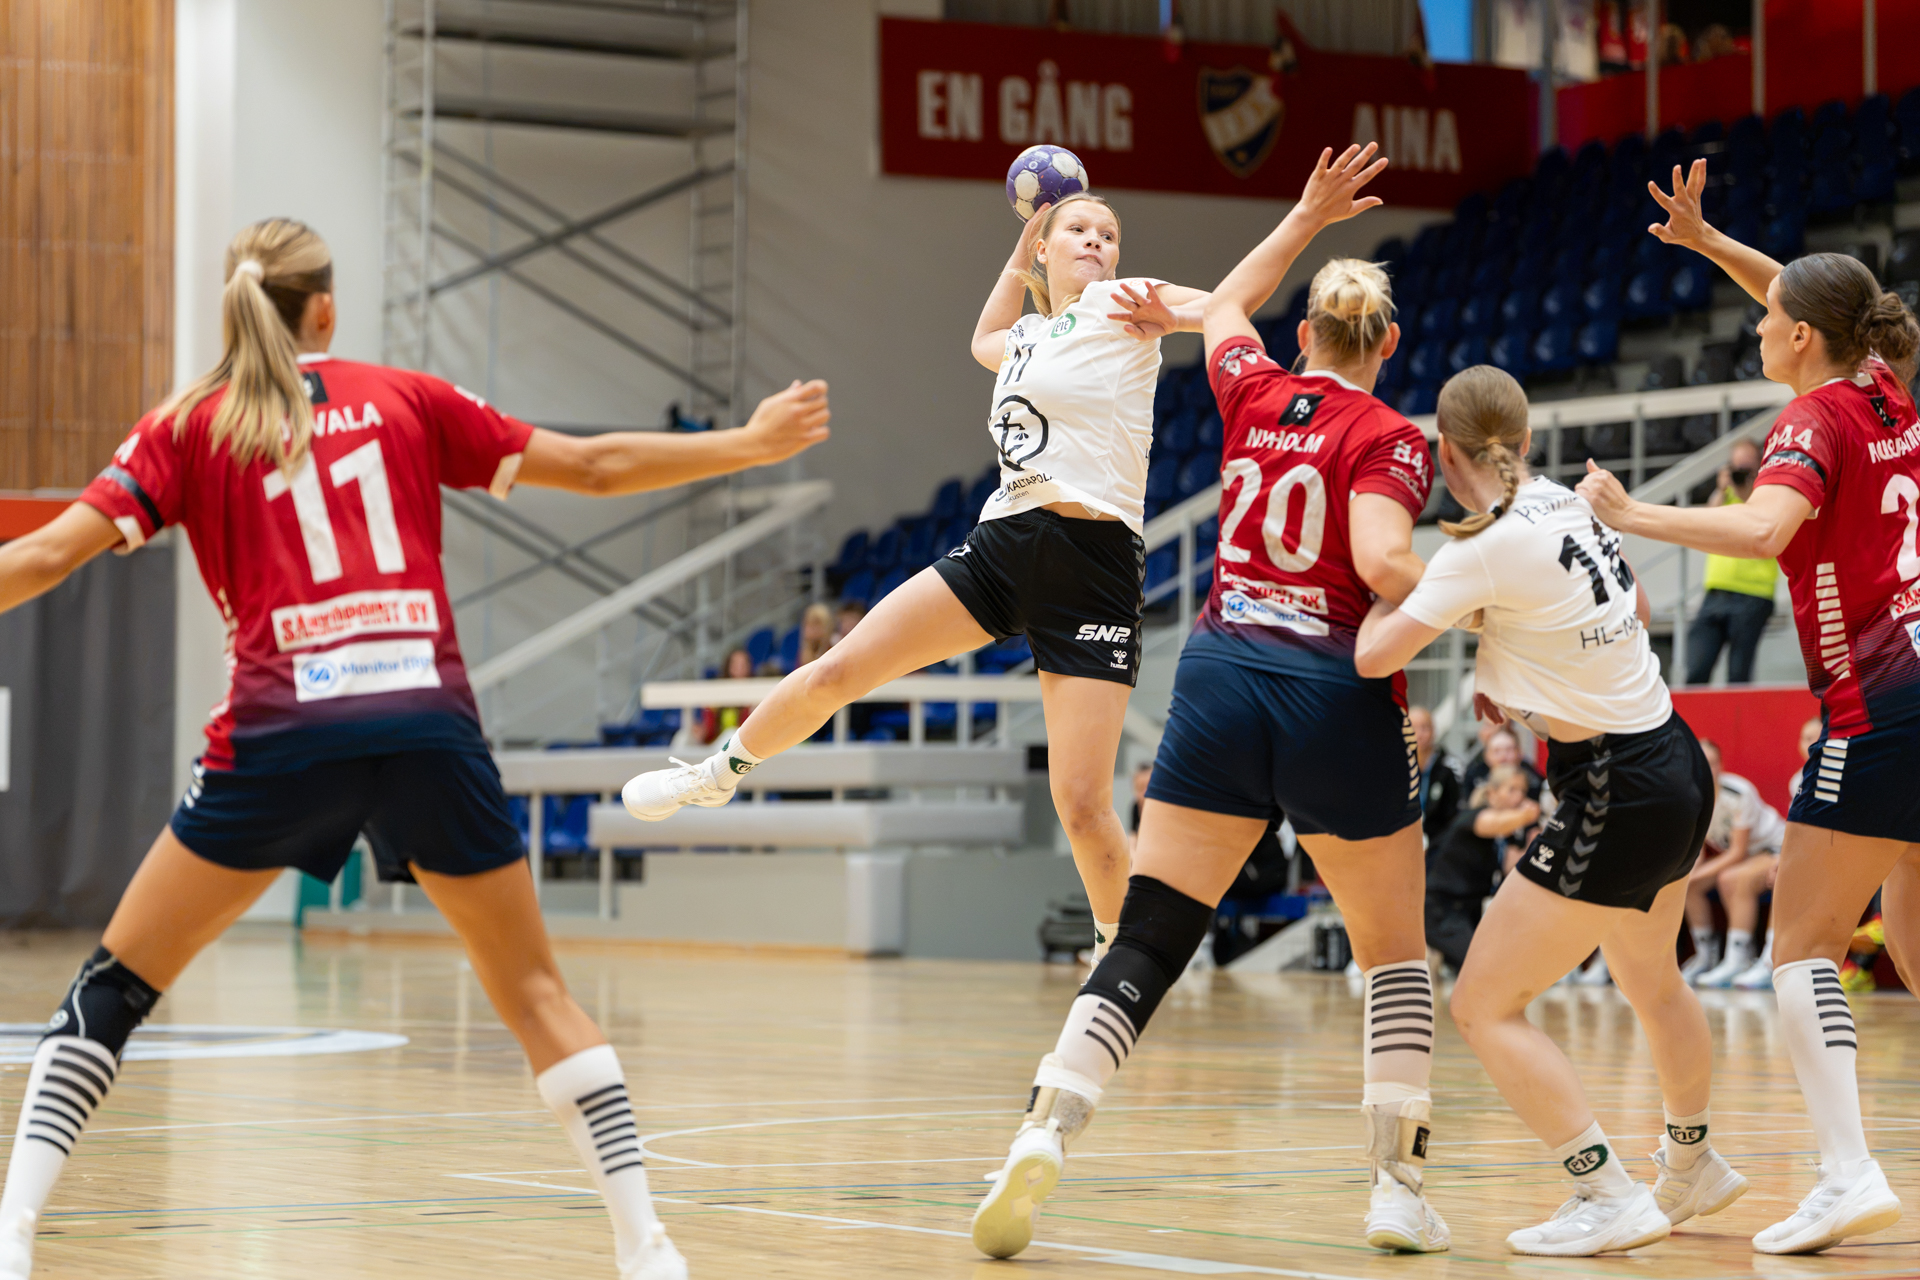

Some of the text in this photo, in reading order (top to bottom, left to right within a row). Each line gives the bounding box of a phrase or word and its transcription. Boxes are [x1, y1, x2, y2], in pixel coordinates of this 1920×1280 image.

[917, 68, 984, 142] EN
[998, 58, 1134, 152] GÅNG
[1350, 101, 1463, 175] AINA
[1245, 426, 1326, 453] NYHOLM
[262, 438, 406, 584] 11
[1220, 457, 1326, 573] 20
[1075, 624, 1131, 643] SNP
